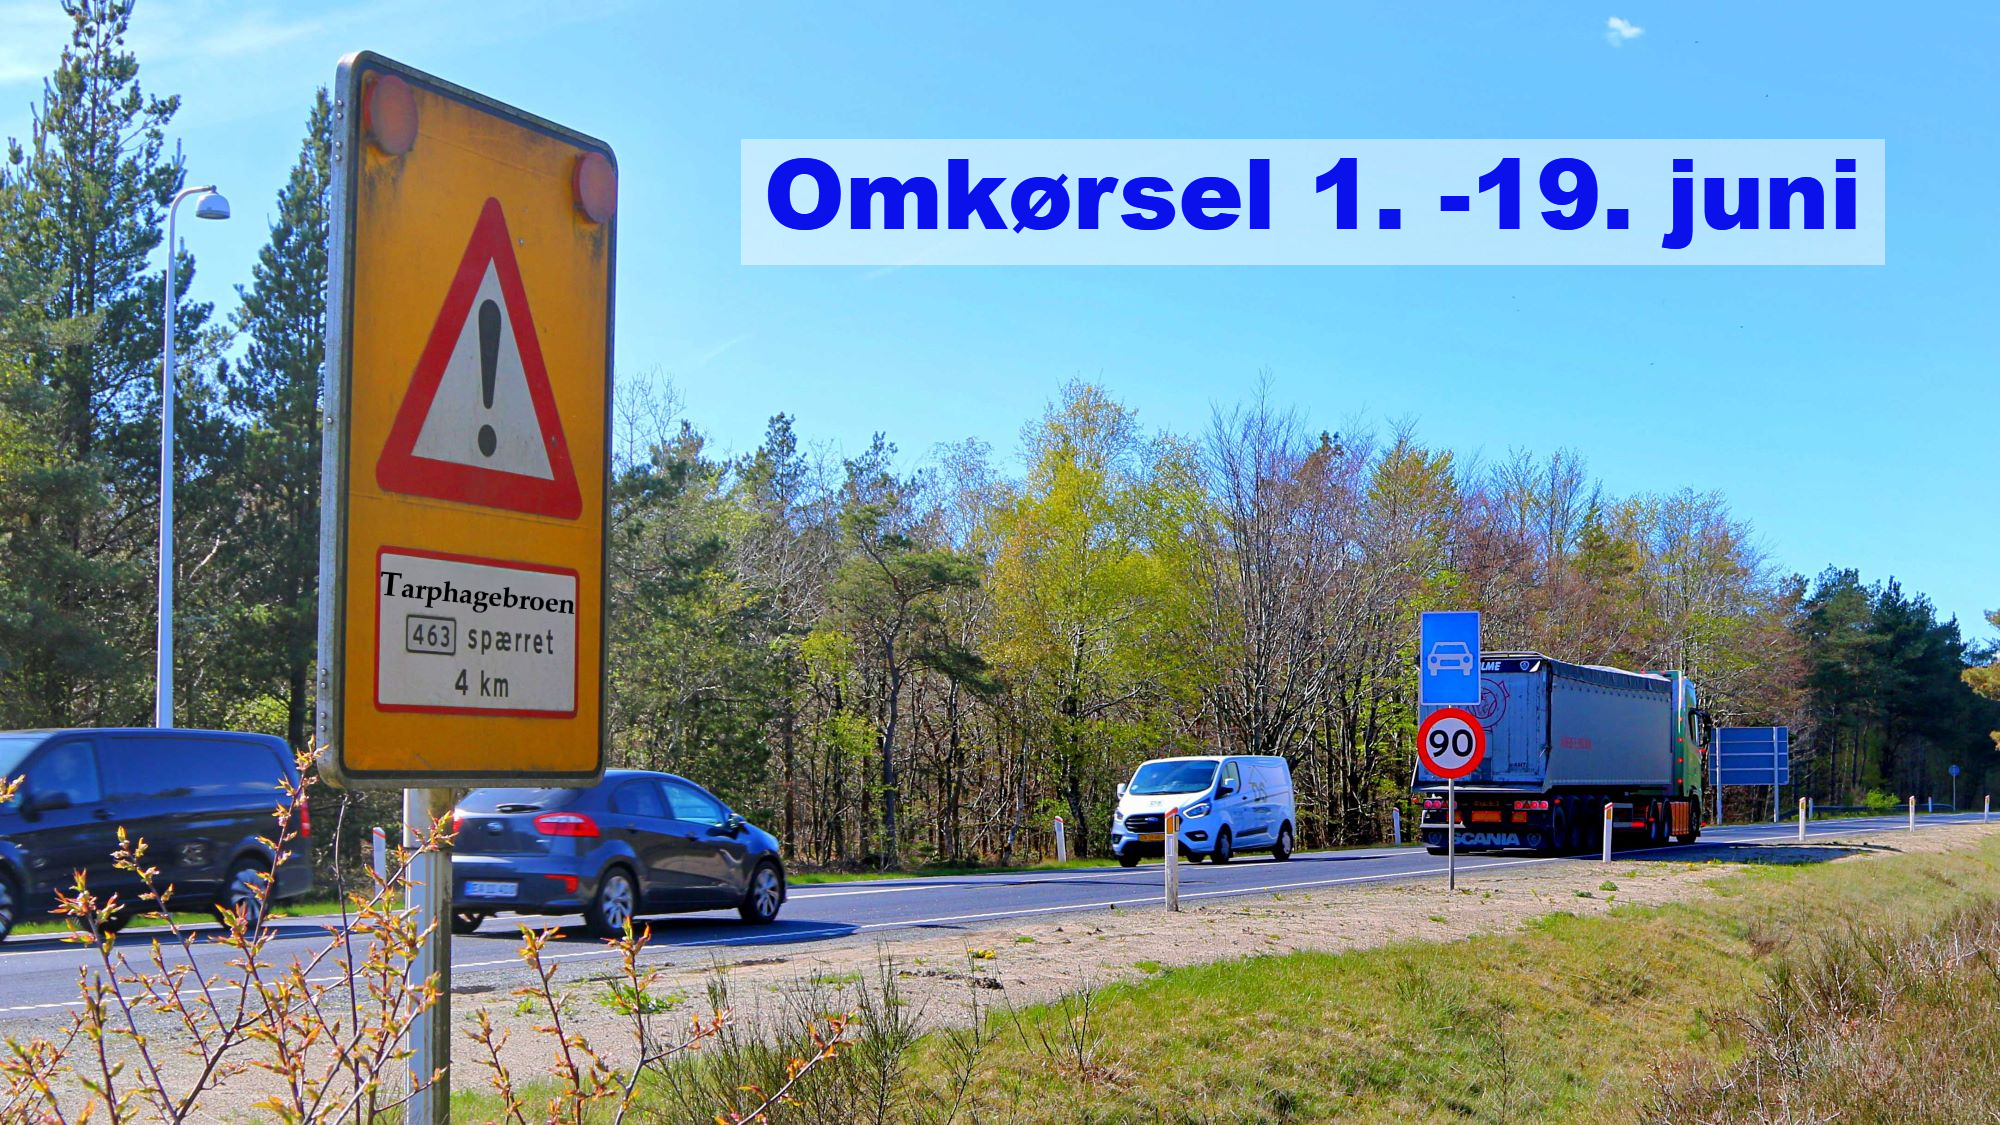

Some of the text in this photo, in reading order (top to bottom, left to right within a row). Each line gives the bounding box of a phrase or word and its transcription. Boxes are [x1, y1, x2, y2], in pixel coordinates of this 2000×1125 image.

[381, 571, 575, 615] Tarphagebroen
[412, 623, 554, 655] 463 spærret
[454, 669, 509, 698] 4 km
[1429, 729, 1473, 758] 90
